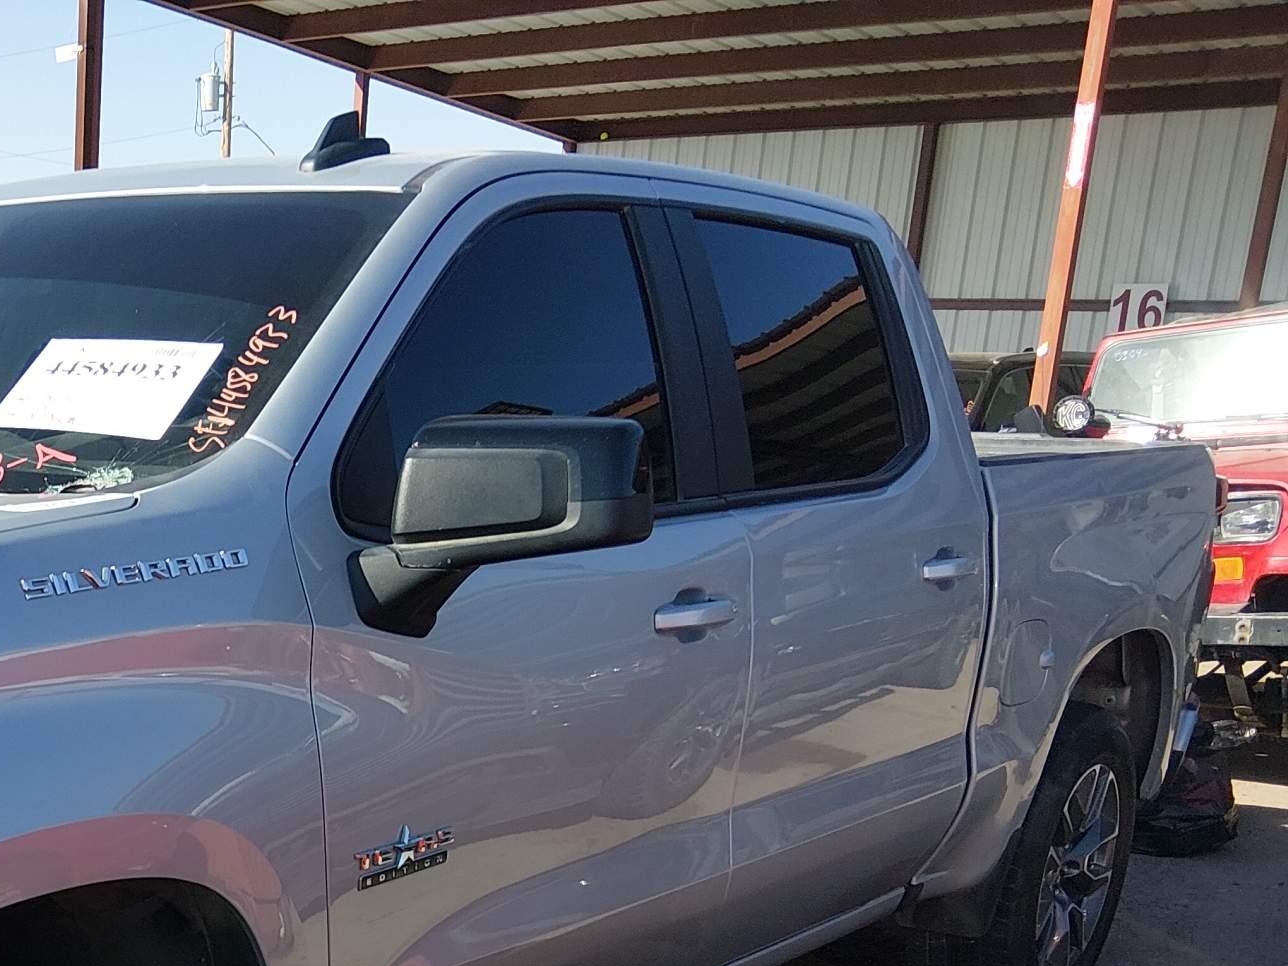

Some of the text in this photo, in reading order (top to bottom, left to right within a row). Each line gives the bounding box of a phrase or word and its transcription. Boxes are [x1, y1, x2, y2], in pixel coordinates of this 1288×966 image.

[1113, 288, 1164, 332] 16
[20, 547, 249, 601] SILVERADO
[366, 856, 444, 887] EDITION
